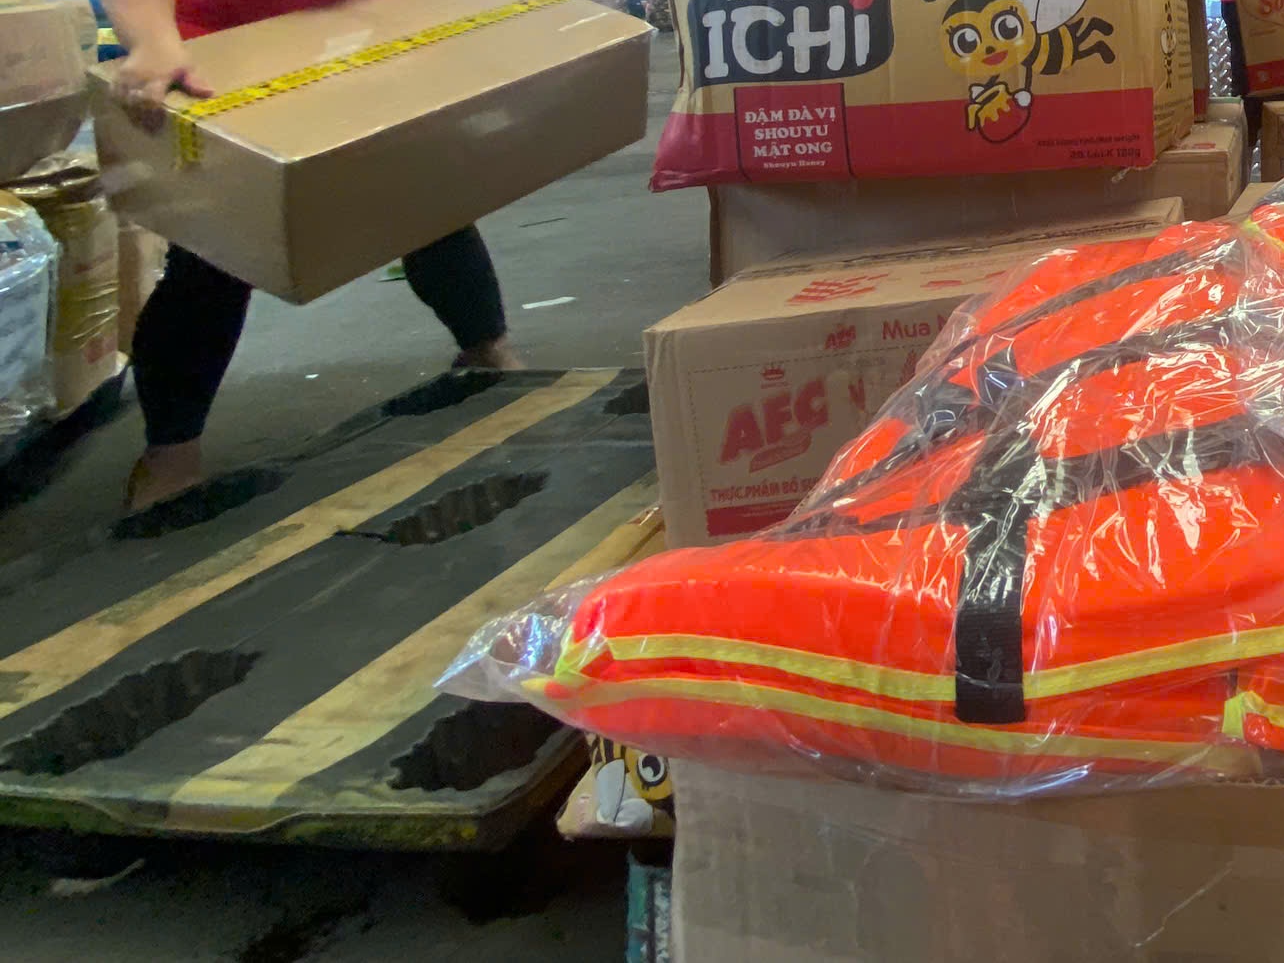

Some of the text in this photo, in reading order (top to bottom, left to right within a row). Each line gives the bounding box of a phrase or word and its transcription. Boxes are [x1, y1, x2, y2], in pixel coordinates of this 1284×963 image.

[745, 105, 836, 126] ĐẬM ĐÀ VỊ
[754, 125, 828, 140] SHOUYU
[754, 141, 832, 159] MẬT ONG
[764, 161, 796, 169] Shouyu
[882, 318, 931, 340] Mua
[718, 375, 829, 467] AFC
